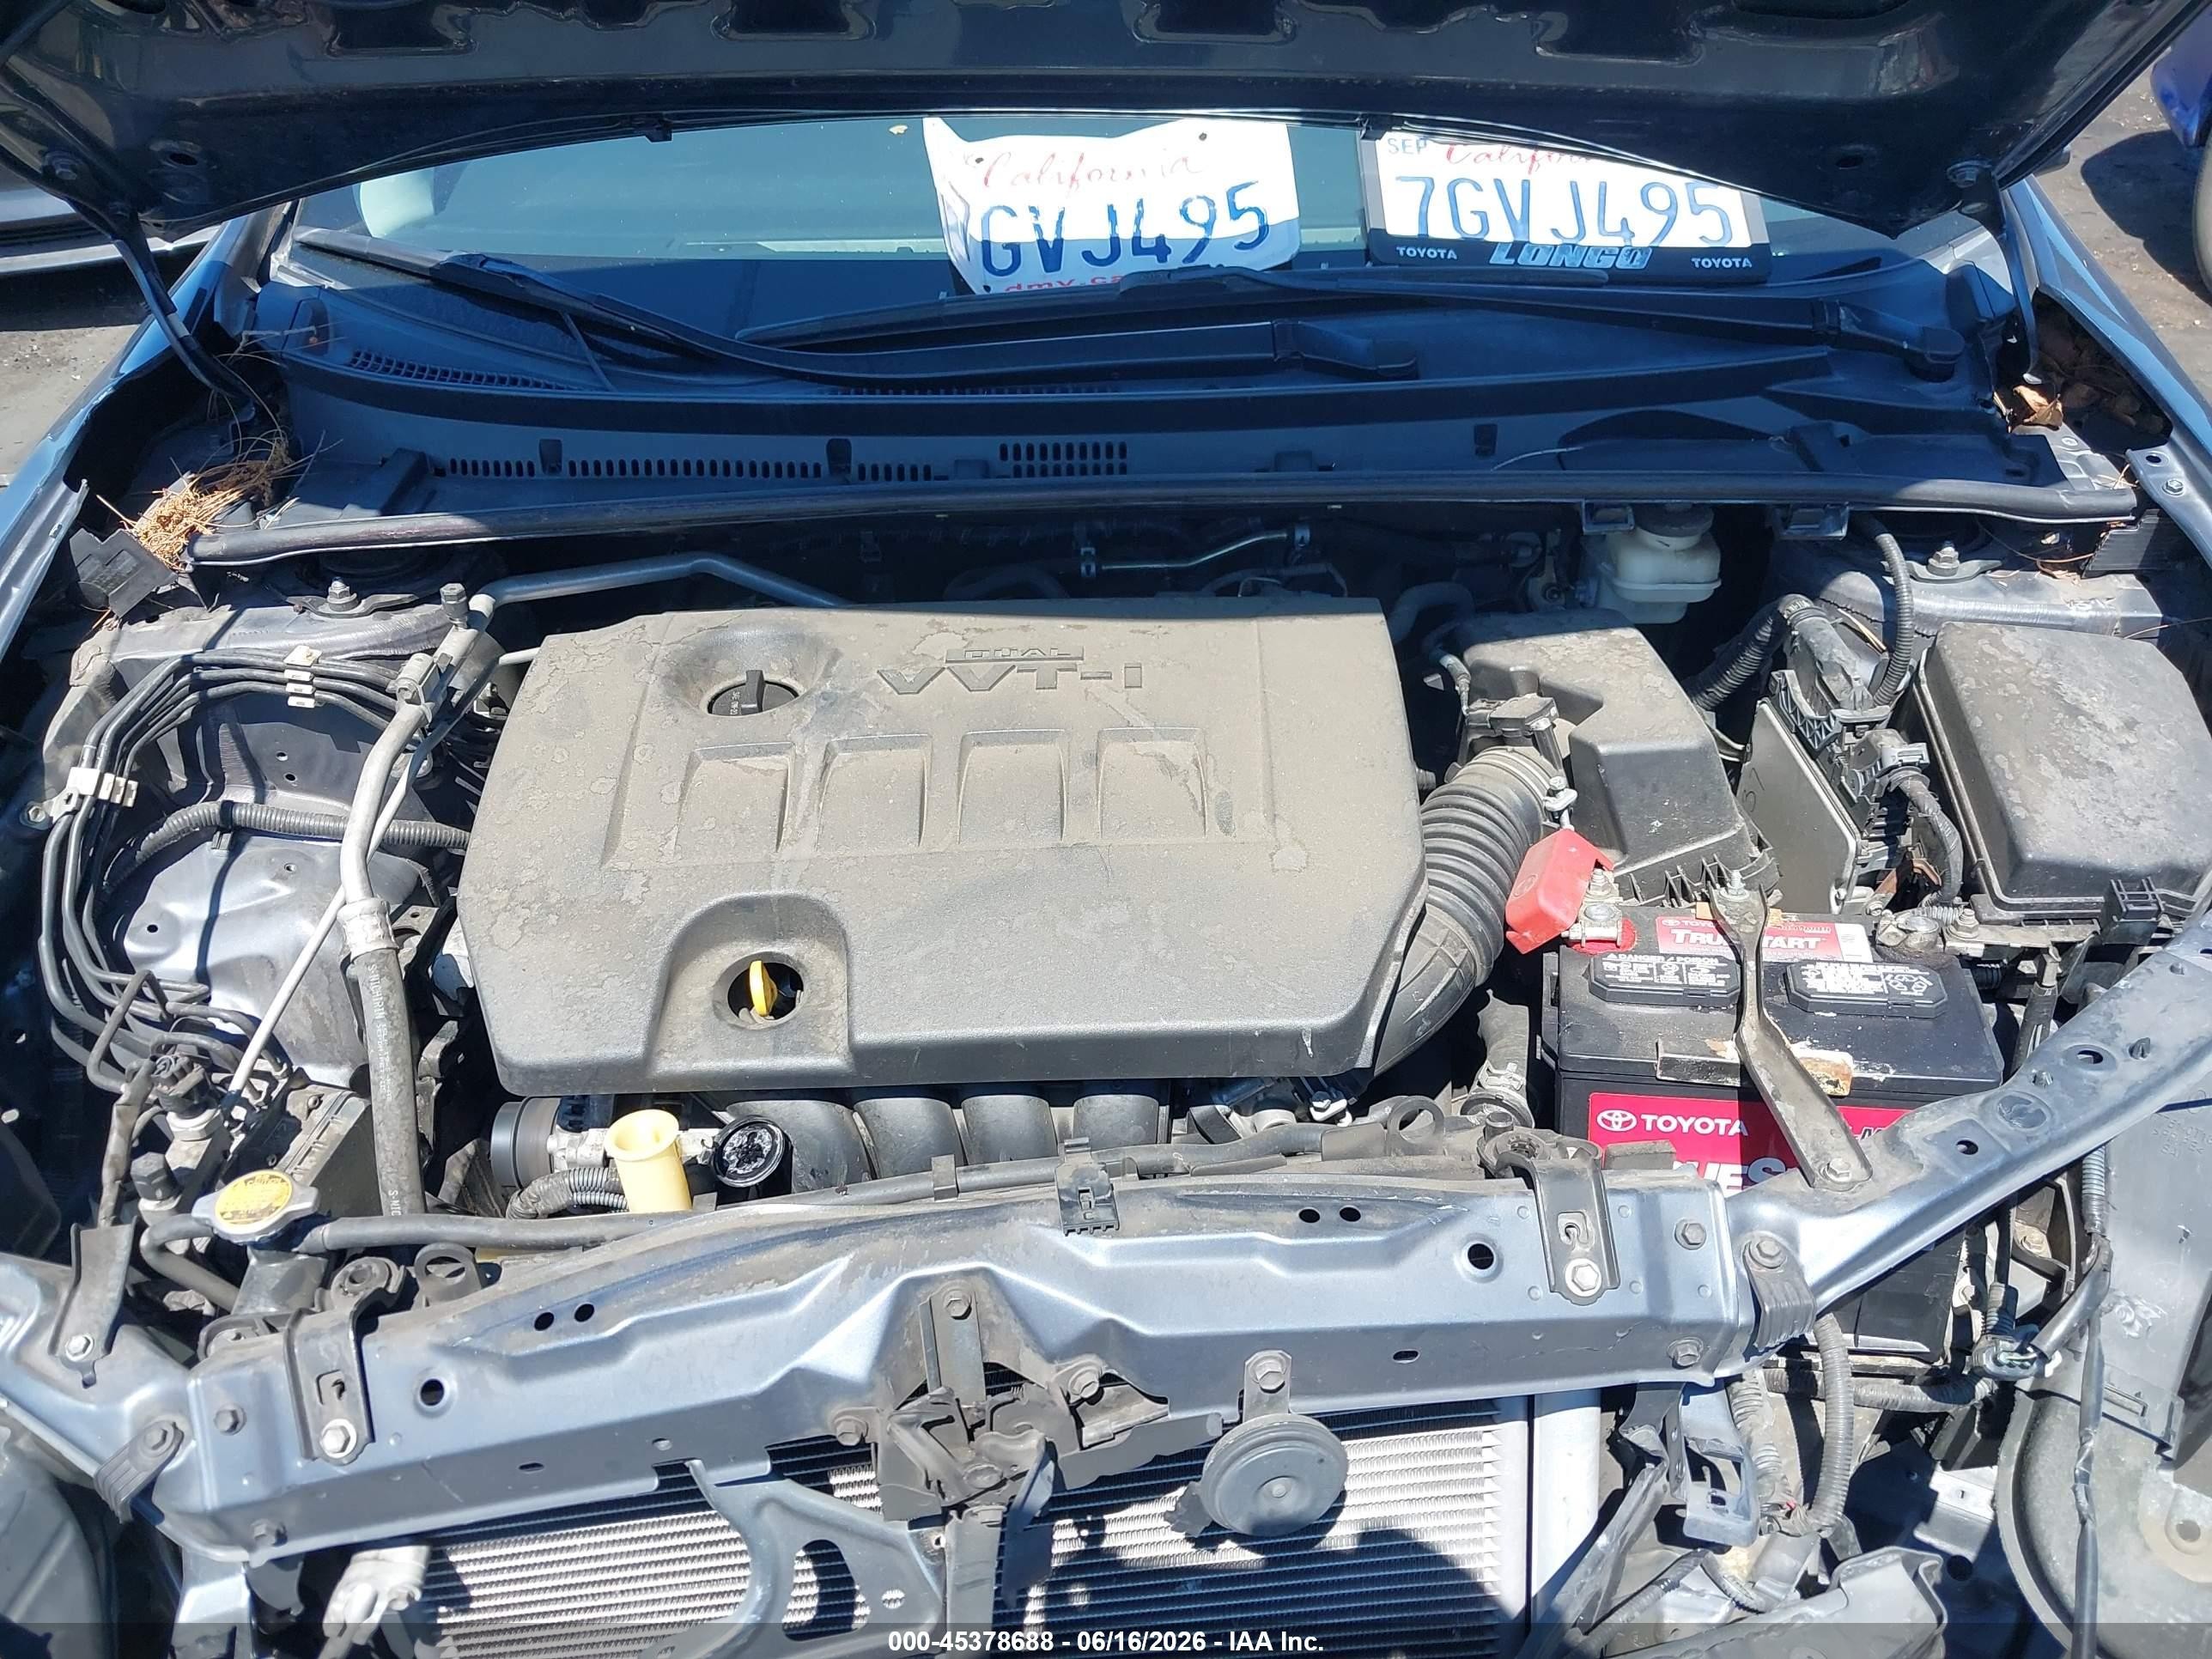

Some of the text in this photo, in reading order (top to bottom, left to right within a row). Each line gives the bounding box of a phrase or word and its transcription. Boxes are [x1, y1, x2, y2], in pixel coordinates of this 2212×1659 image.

[1395, 175, 1733, 247] 7GVJ495
[1396, 246, 1457, 260] TOYOTA
[1490, 243, 1650, 270] LONGO
[1691, 257, 1753, 269] TOYOTA
[1639, 1114, 1748, 1137] TOYOTA
